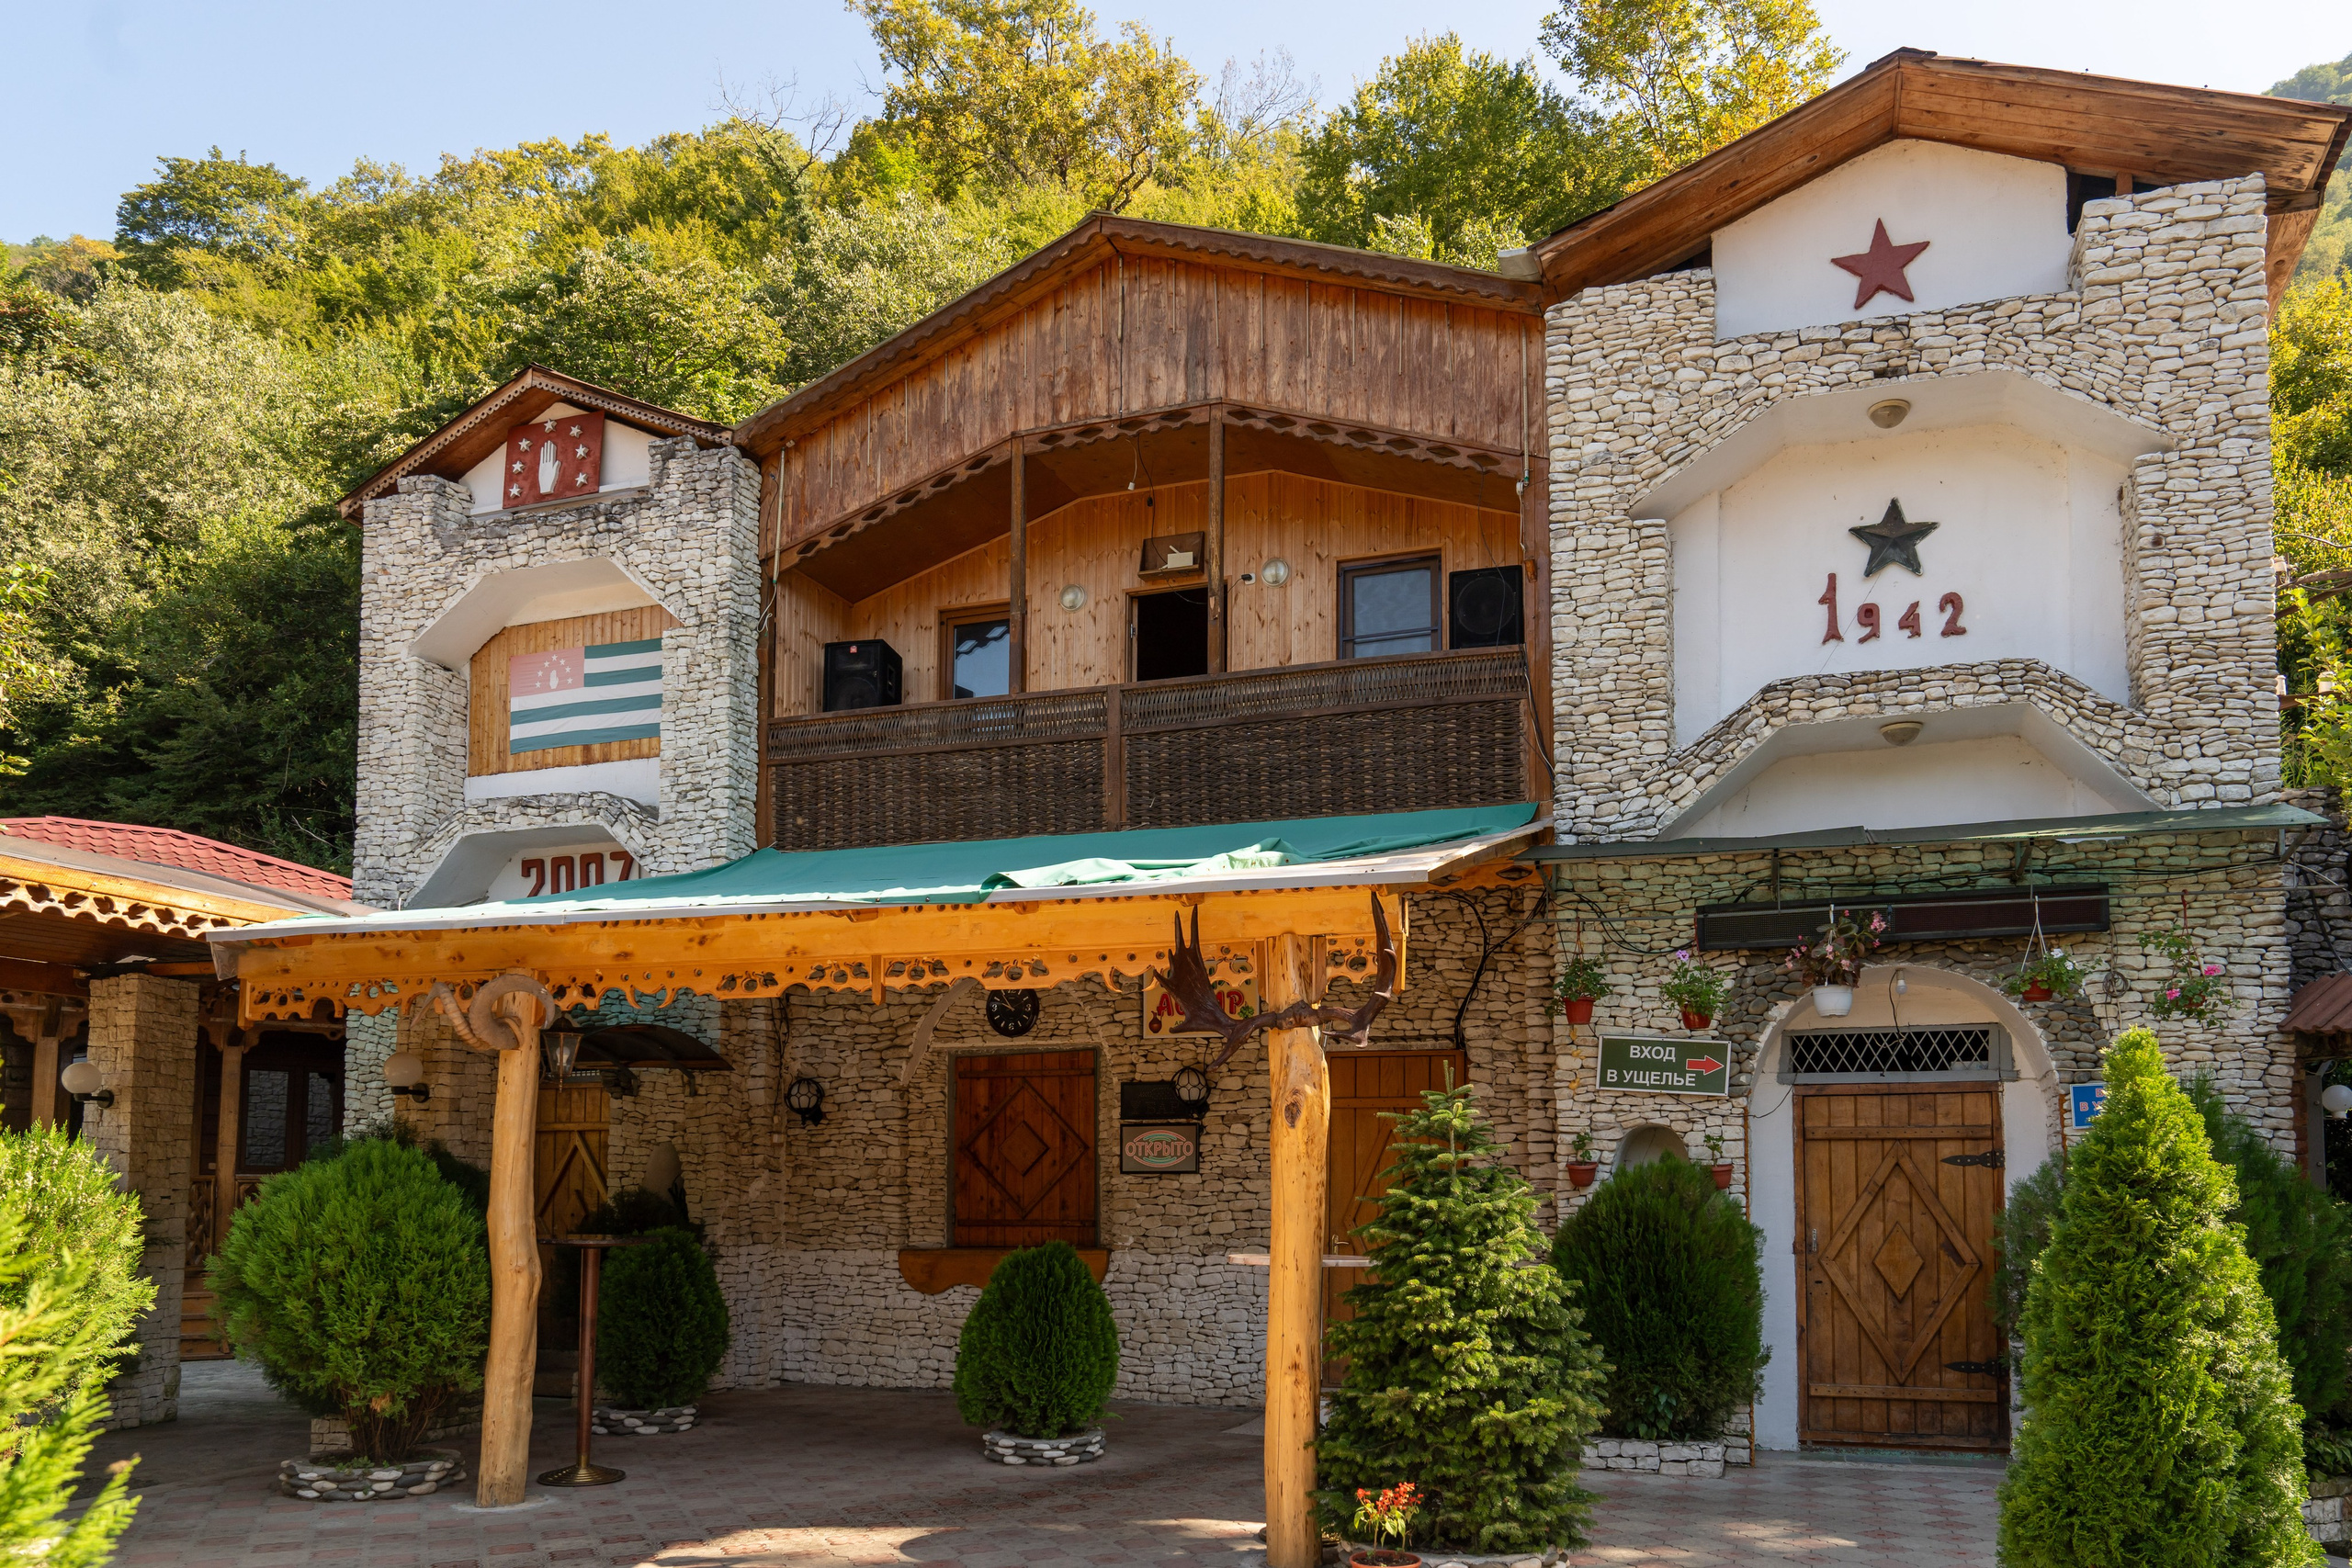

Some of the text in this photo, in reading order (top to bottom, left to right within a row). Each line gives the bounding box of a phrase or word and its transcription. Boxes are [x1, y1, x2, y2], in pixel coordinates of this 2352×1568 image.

[1817, 572, 1967, 645] 1942
[521, 851, 634, 897] 2007
[991, 1004, 998, 1012] 9
[1024, 1003, 1032, 1011] 3
[1008, 1022, 1014, 1031] 6
[1629, 1044, 1676, 1063] ВХОД
[1606, 1069, 1696, 1087] В УЩЕЛЬЕ
[1125, 1141, 1194, 1157] ОТКРЫТО
